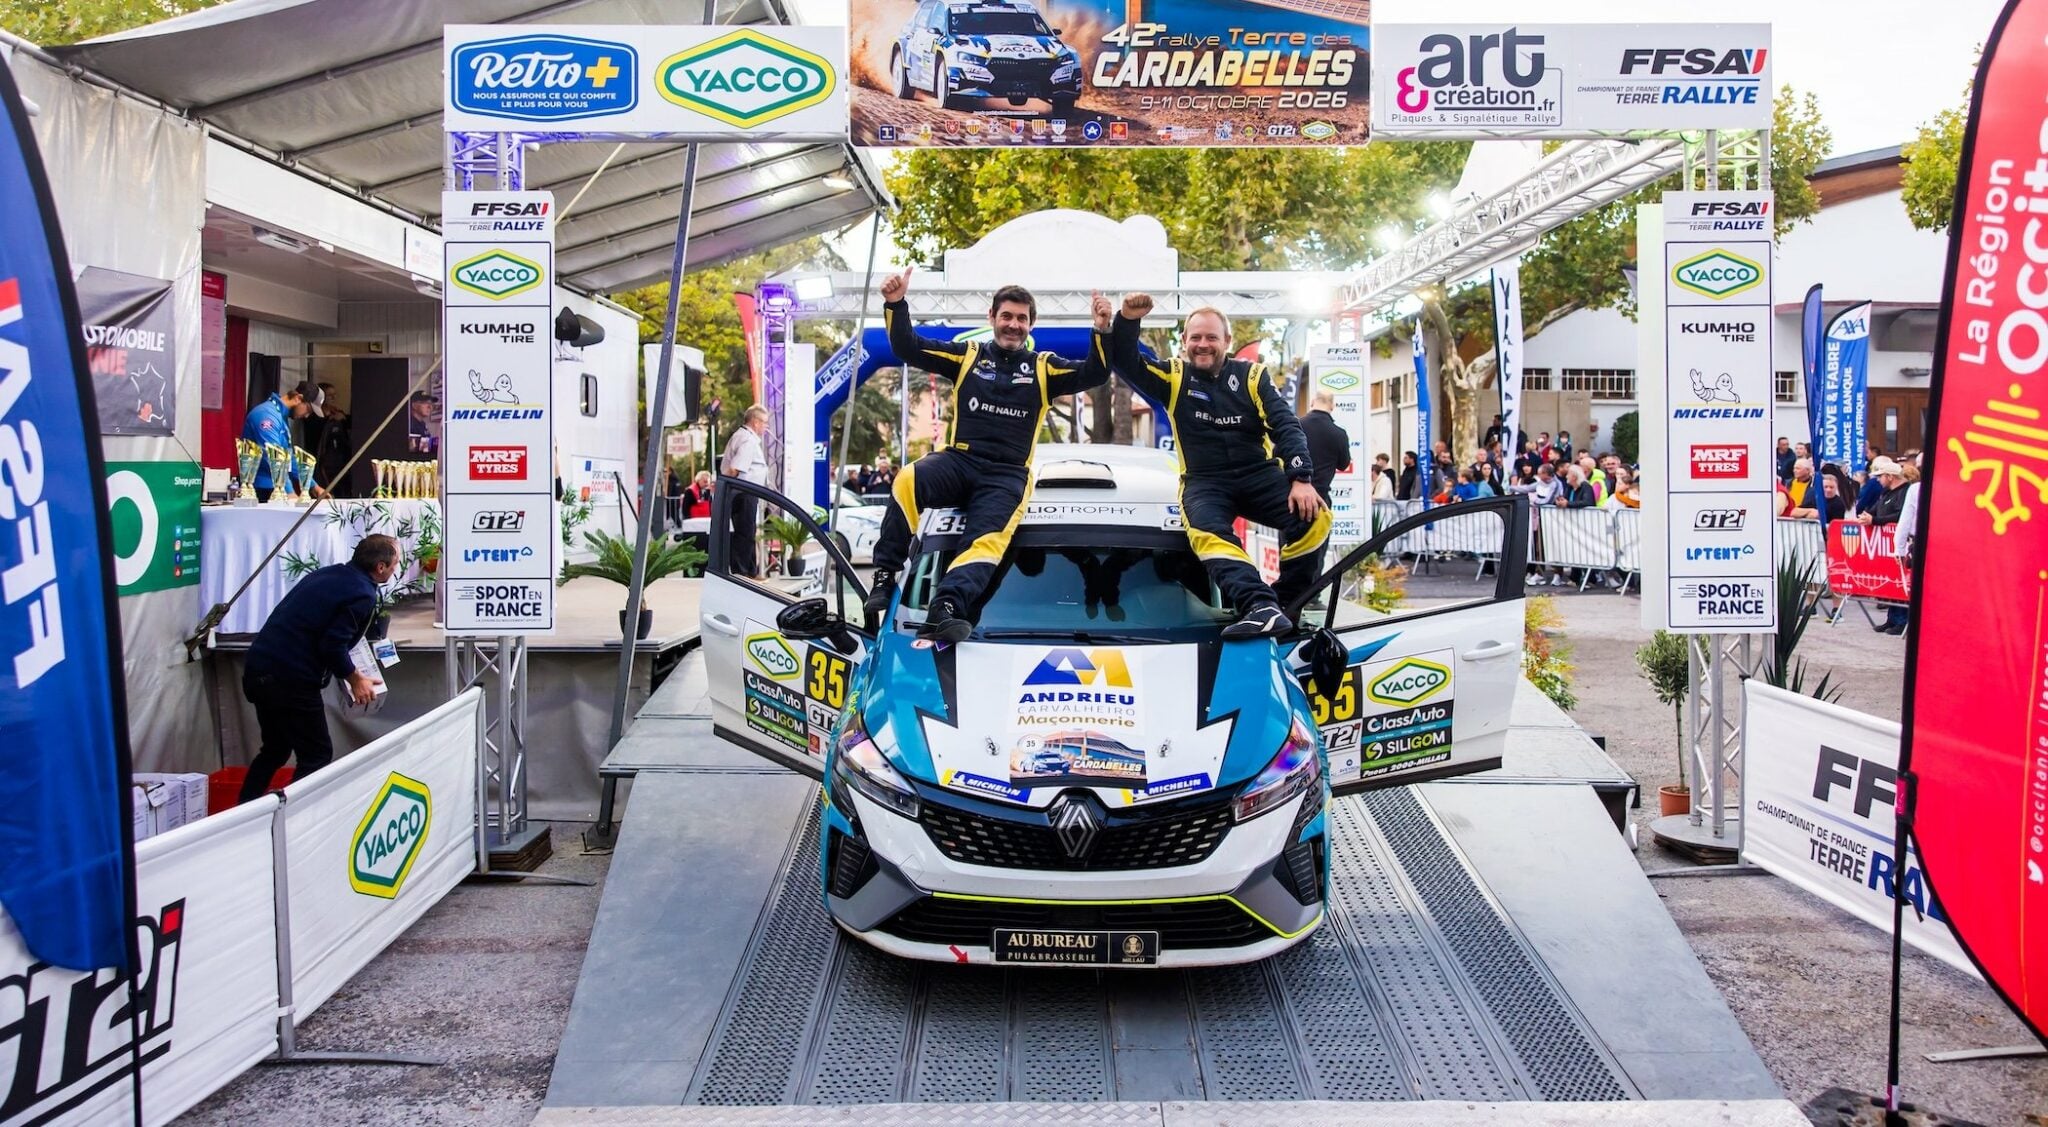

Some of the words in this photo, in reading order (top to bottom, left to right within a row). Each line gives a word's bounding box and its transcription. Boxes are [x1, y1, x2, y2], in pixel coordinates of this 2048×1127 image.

[1158, 33, 1220, 46] rallye
[1228, 28, 1307, 45] Terre
[1311, 32, 1353, 45] des
[1418, 27, 1545, 88] art
[1620, 49, 1750, 75] FFSA
[1092, 51, 1357, 87] CARDABELLES
[684, 67, 808, 93] YACCO
[1177, 95, 1273, 109] OCTOBRE
[1278, 91, 1348, 108] 2026
[1616, 94, 1659, 104] TERRE
[1662, 86, 1758, 104] RALLYE
[1391, 113, 1433, 124] Plaques
[1439, 113, 1447, 122] &
[1453, 113, 1518, 124] Signalétique
[1524, 113, 1556, 124] Rallye
[471, 203, 540, 216] FFSA
[1691, 202, 1759, 216] FFSA
[493, 221, 544, 231] RALLYE
[1713, 220, 1764, 230] RALLYE
[1965, 158, 2014, 307] Région
[466, 269, 530, 282] YACCO
[1687, 268, 1750, 282] YACCO
[460, 323, 534, 334] KUMHO
[1682, 322, 1755, 334] KUMHO
[1832, 318, 1866, 335] AXA
[82, 325, 166, 352] UTOMOBILE
[501, 335, 534, 343] TIRE
[1721, 334, 1755, 342] TIRE
[1958, 319, 1991, 365] La
[1827, 341, 1840, 390] FABRE
[1842, 366, 1853, 414] BANQUE
[452, 409, 543, 420] MICHELIN
[981, 402, 1029, 418] RENAULT
[1673, 408, 1764, 419] MICHELIN
[1856, 391, 1864, 436] AFFRIQUE
[1826, 405, 1838, 456] ROUVE
[470, 450, 525, 463] MRF
[1692, 449, 1747, 462] MRF
[1842, 417, 1853, 478] URANCE
[477, 464, 519, 474] TYRES
[1698, 462, 1740, 473] TYRES
[471, 511, 525, 530] GT2i
[1694, 509, 1746, 529] GT2i
[476, 586, 529, 600] SPORT
[529, 591, 542, 600] EN
[1698, 584, 1750, 598] SPORT
[1750, 589, 1764, 598] EN
[476, 603, 542, 616] FRANCE
[1698, 600, 1764, 615] FRANCE
[754, 644, 794, 671] YACCO
[809, 651, 847, 709] 35
[1381, 673, 1439, 694] YACCO
[747, 673, 802, 710] ClassAuto
[1019, 692, 1135, 705] ANDRIEU
[762, 705, 804, 734] SILIGOM
[1017, 705, 1136, 716] CARVALHEIRO
[1367, 706, 1446, 733] ClassAuto
[1017, 715, 1135, 728] Maçonnerie
[1026, 740, 1036, 748] 35
[1322, 722, 1362, 750] T2i
[1387, 730, 1446, 754] SILIGOM
[1073, 760, 1142, 772] CARDABELLES
[1362, 767, 1388, 777] Pneus
[1389, 753, 1448, 772] 2000-MILLAU
[966, 779, 1021, 797] MICHELIN
[1148, 778, 1201, 795] MICHELIN
[1813, 744, 1900, 819] FF
[363, 806, 421, 868] YACCO
[1757, 800, 1815, 836] CHAMPIONNAT
[1817, 826, 1829, 841] DE
[1831, 832, 1868, 858] FRANCE
[1809, 838, 1866, 885] TERRE
[1008, 932, 1030, 946] AU
[1033, 934, 1097, 948] BUREAU
